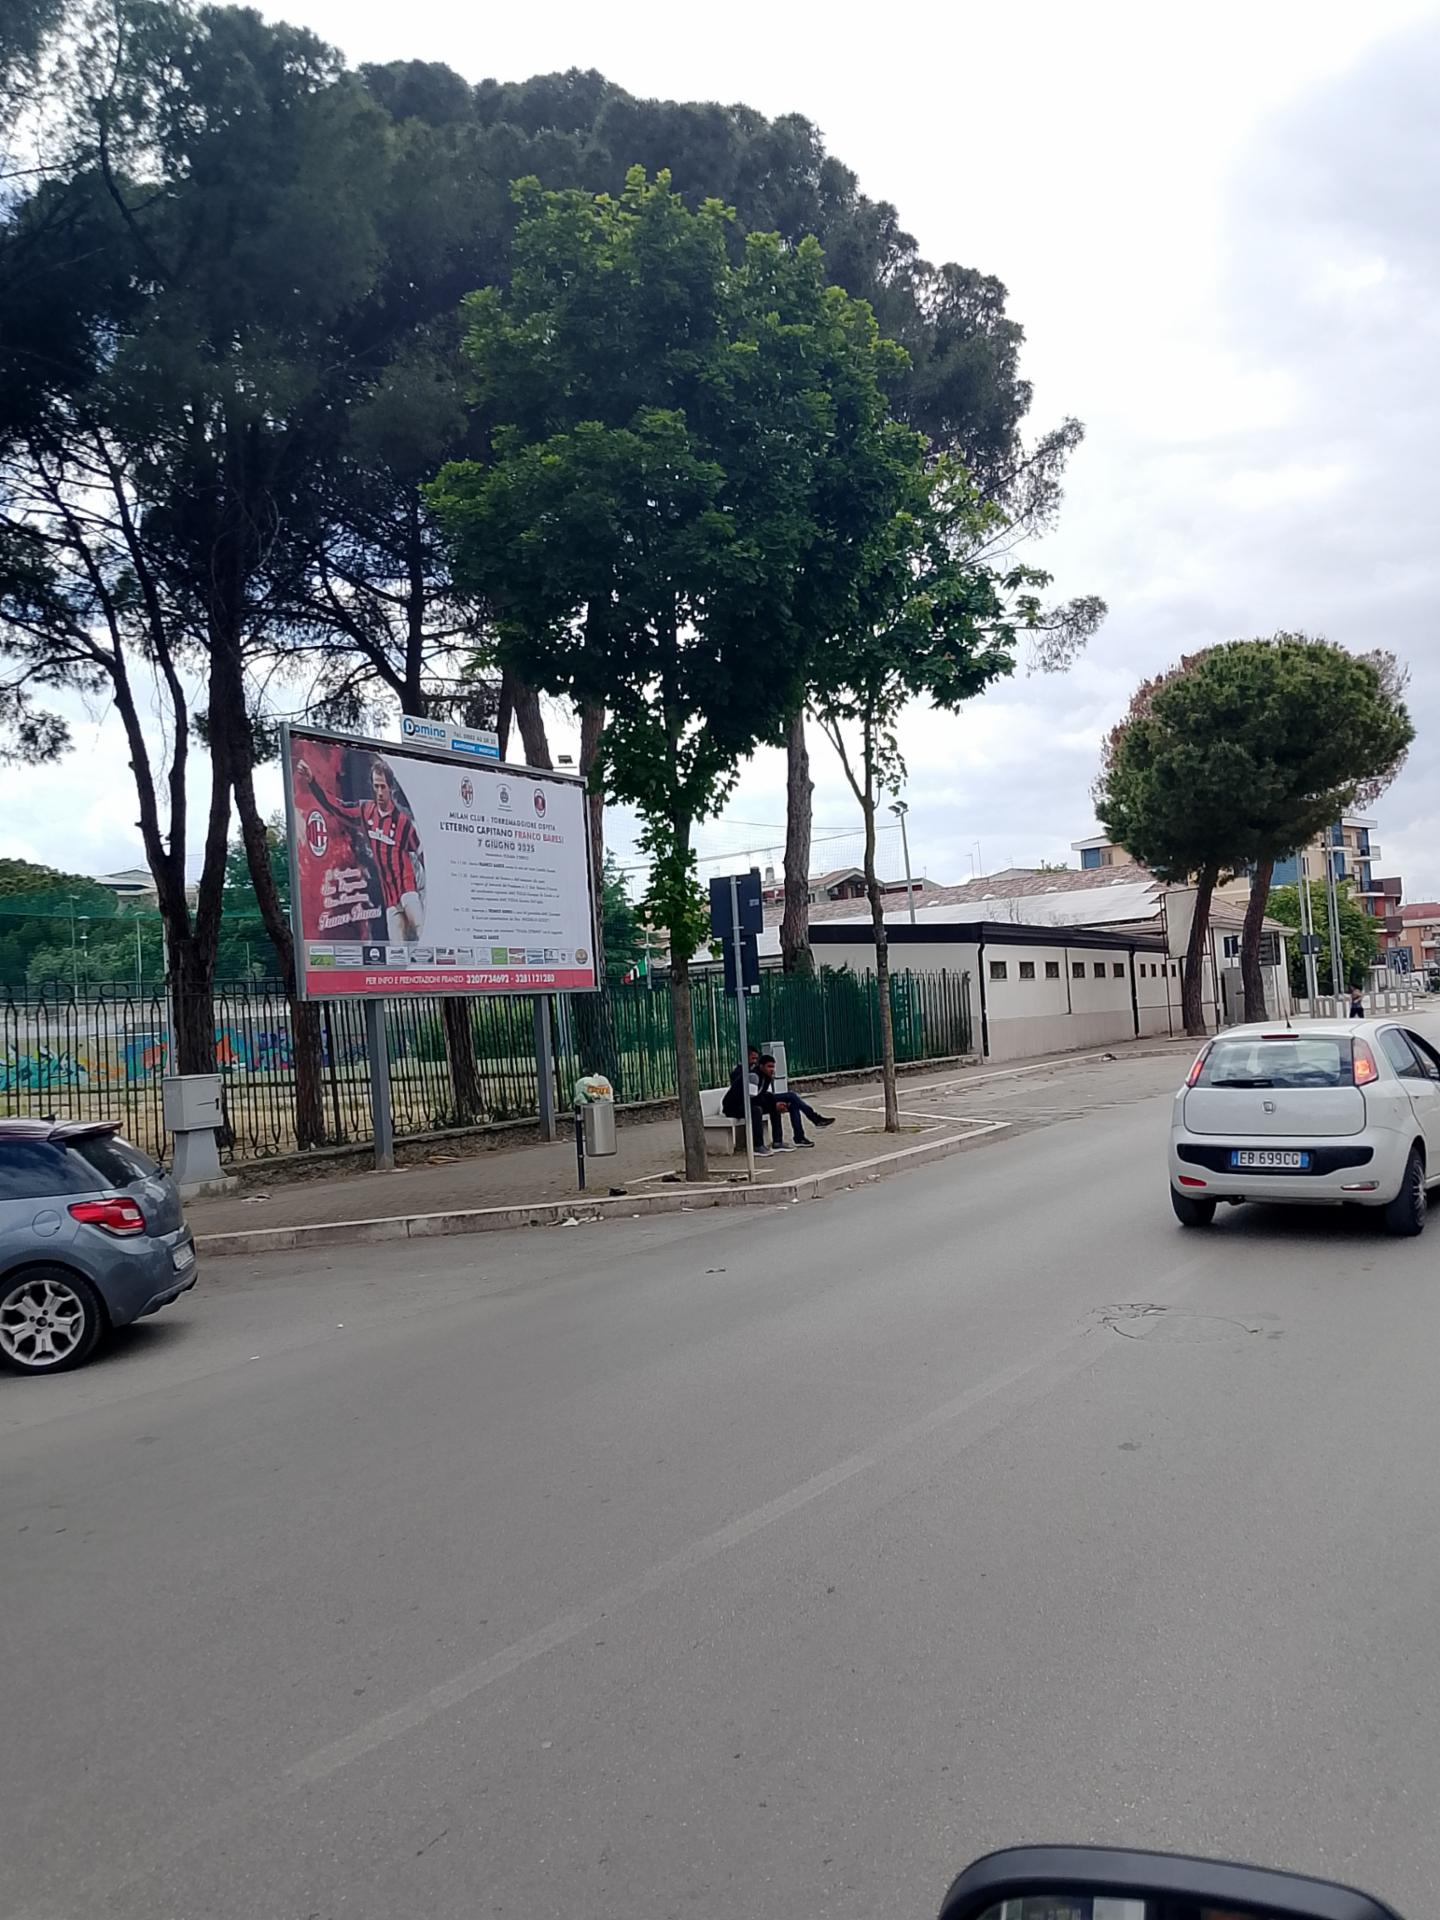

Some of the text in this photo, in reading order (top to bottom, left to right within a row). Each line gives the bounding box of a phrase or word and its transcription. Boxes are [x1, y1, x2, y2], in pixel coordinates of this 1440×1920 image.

[403, 717, 446, 738] Domina
[449, 811, 469, 820] MILAN
[469, 814, 485, 822] CLUB
[490, 817, 537, 829] TORREMAGGIORE
[538, 823, 556, 831] OSPITA
[440, 821, 564, 843] L'ETERNO CAPITANO FRANCO BARESI
[477, 839, 482, 847] 7
[485, 839, 515, 850] GIUGNO
[365, 976, 377, 985] PER
[377, 976, 393, 984] INFO
[394, 976, 399, 984] E
[399, 975, 440, 984] PRENOTAZIONI
[1239, 1152, 1299, 1165] EB 699CG
